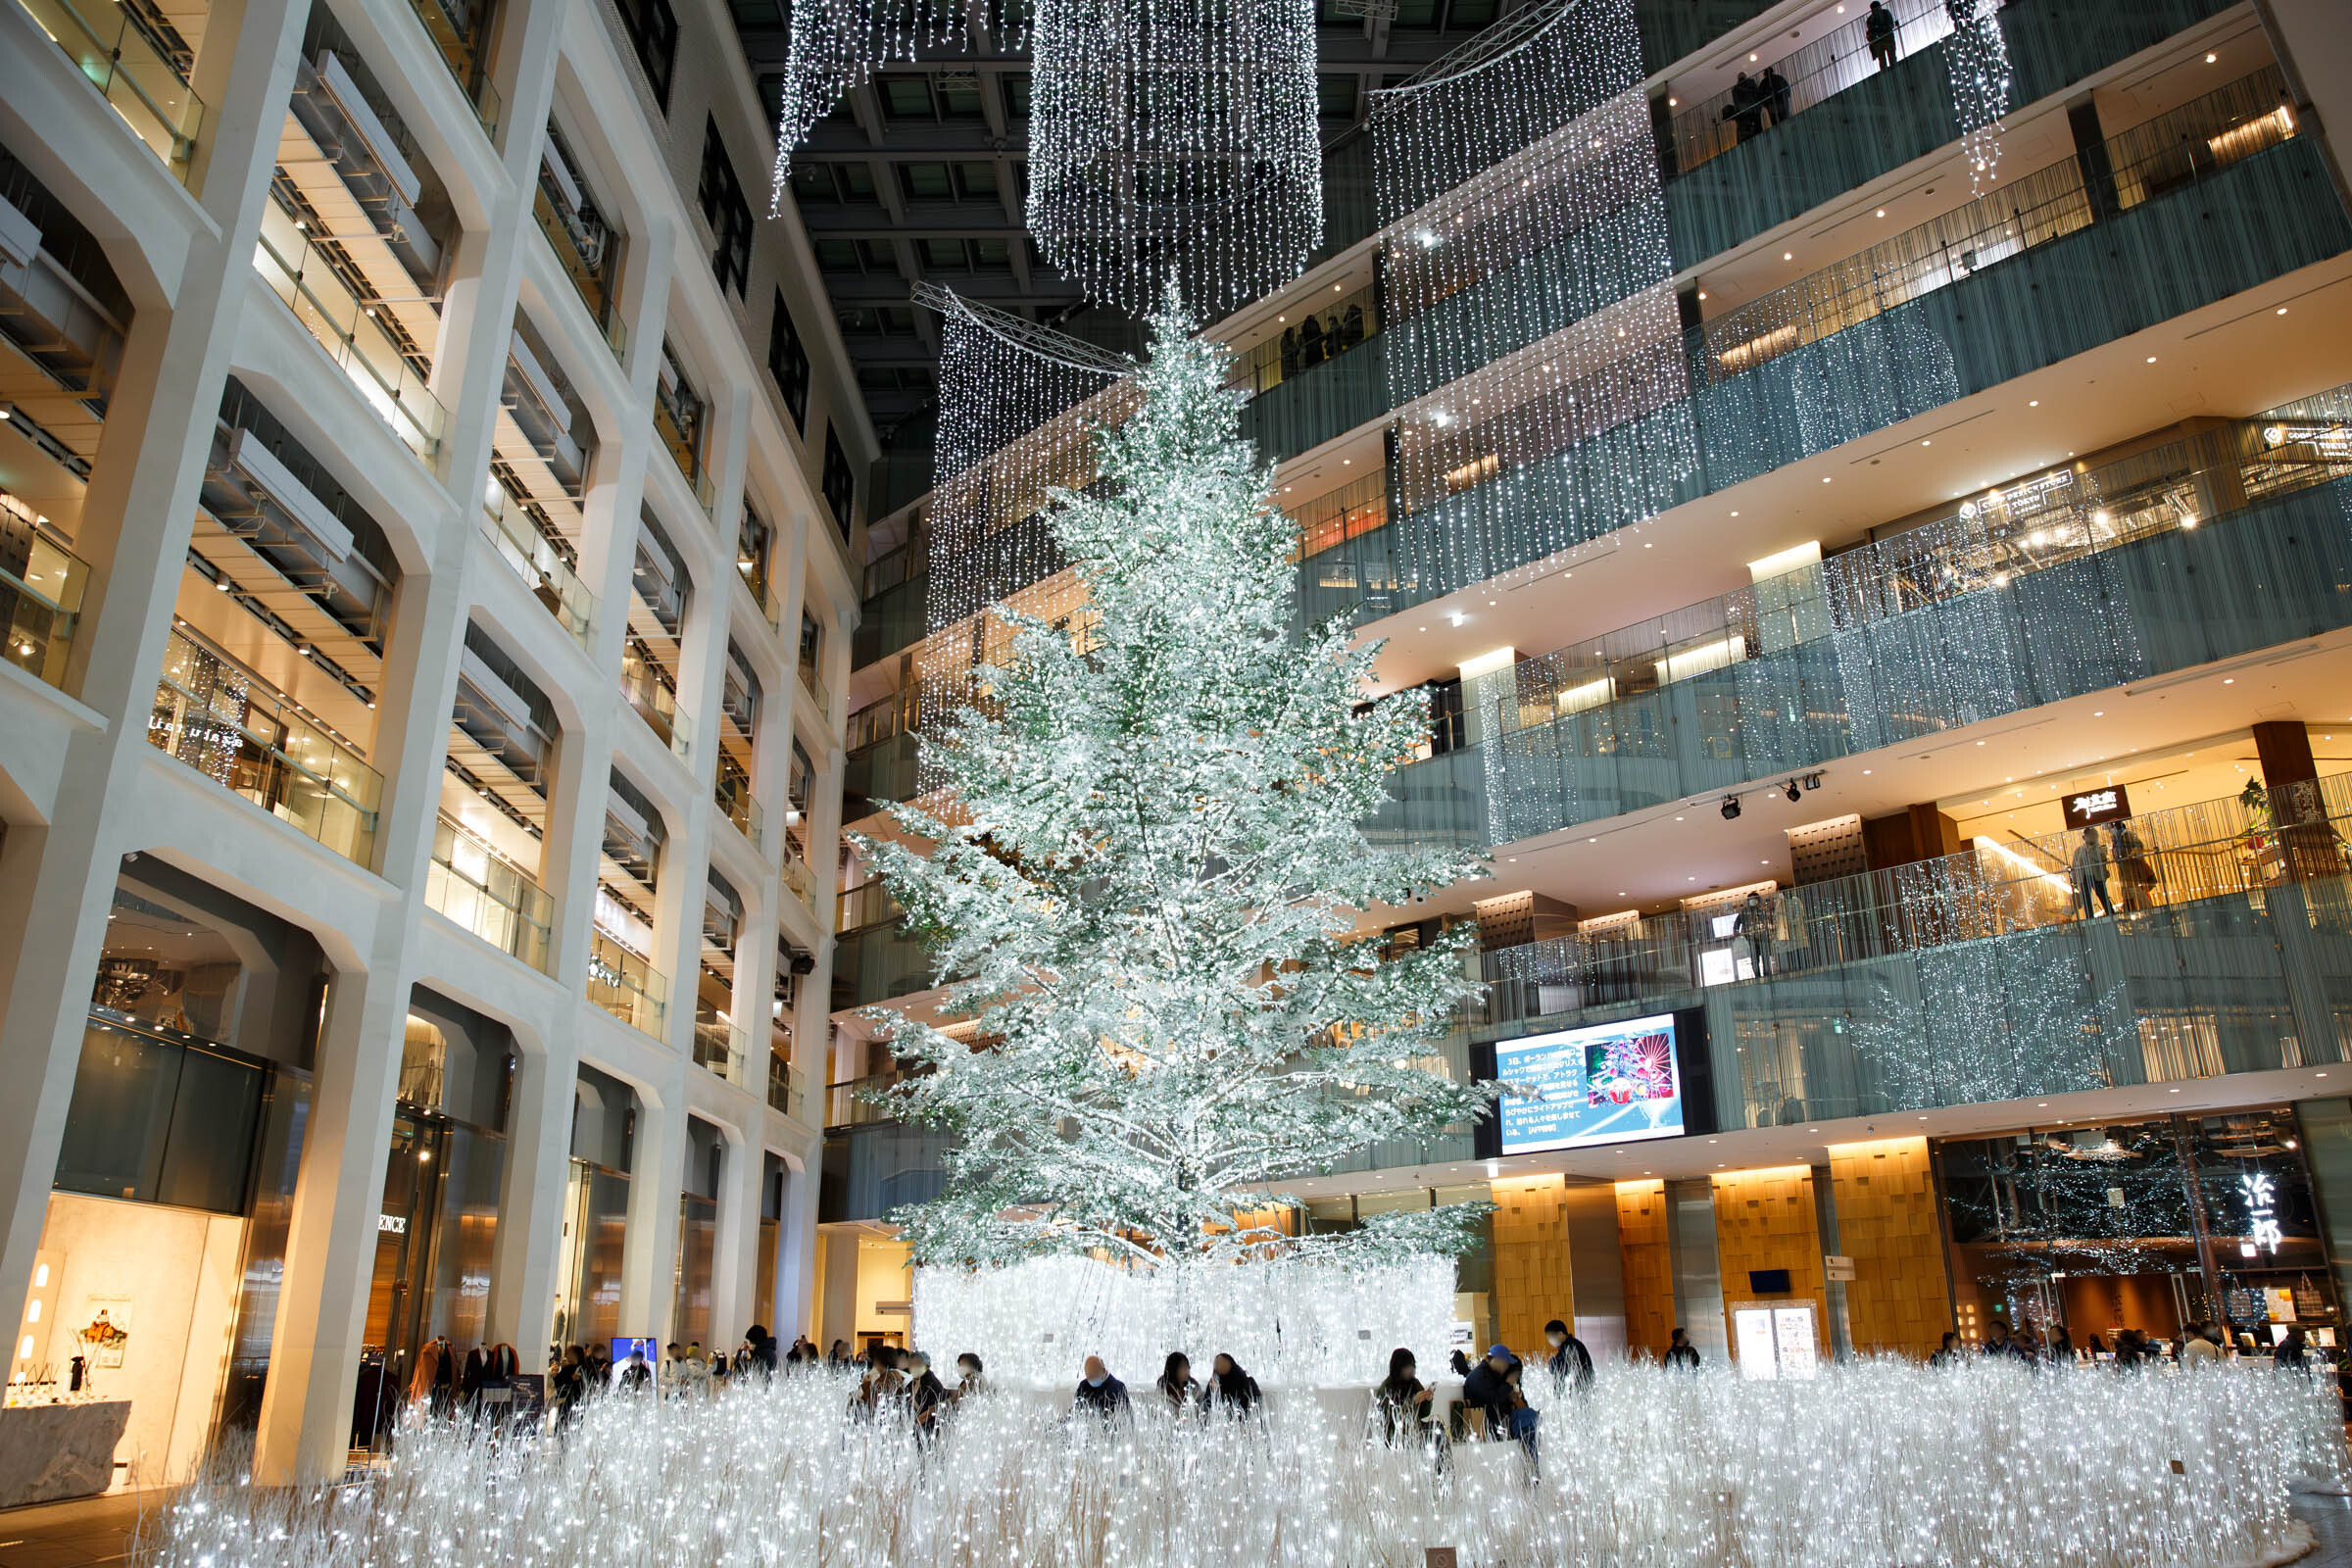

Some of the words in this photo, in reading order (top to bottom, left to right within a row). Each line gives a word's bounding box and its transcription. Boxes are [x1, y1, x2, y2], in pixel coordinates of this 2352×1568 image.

[378, 1214, 406, 1233] ENCE
[2238, 1174, 2281, 1254] 治一郎
